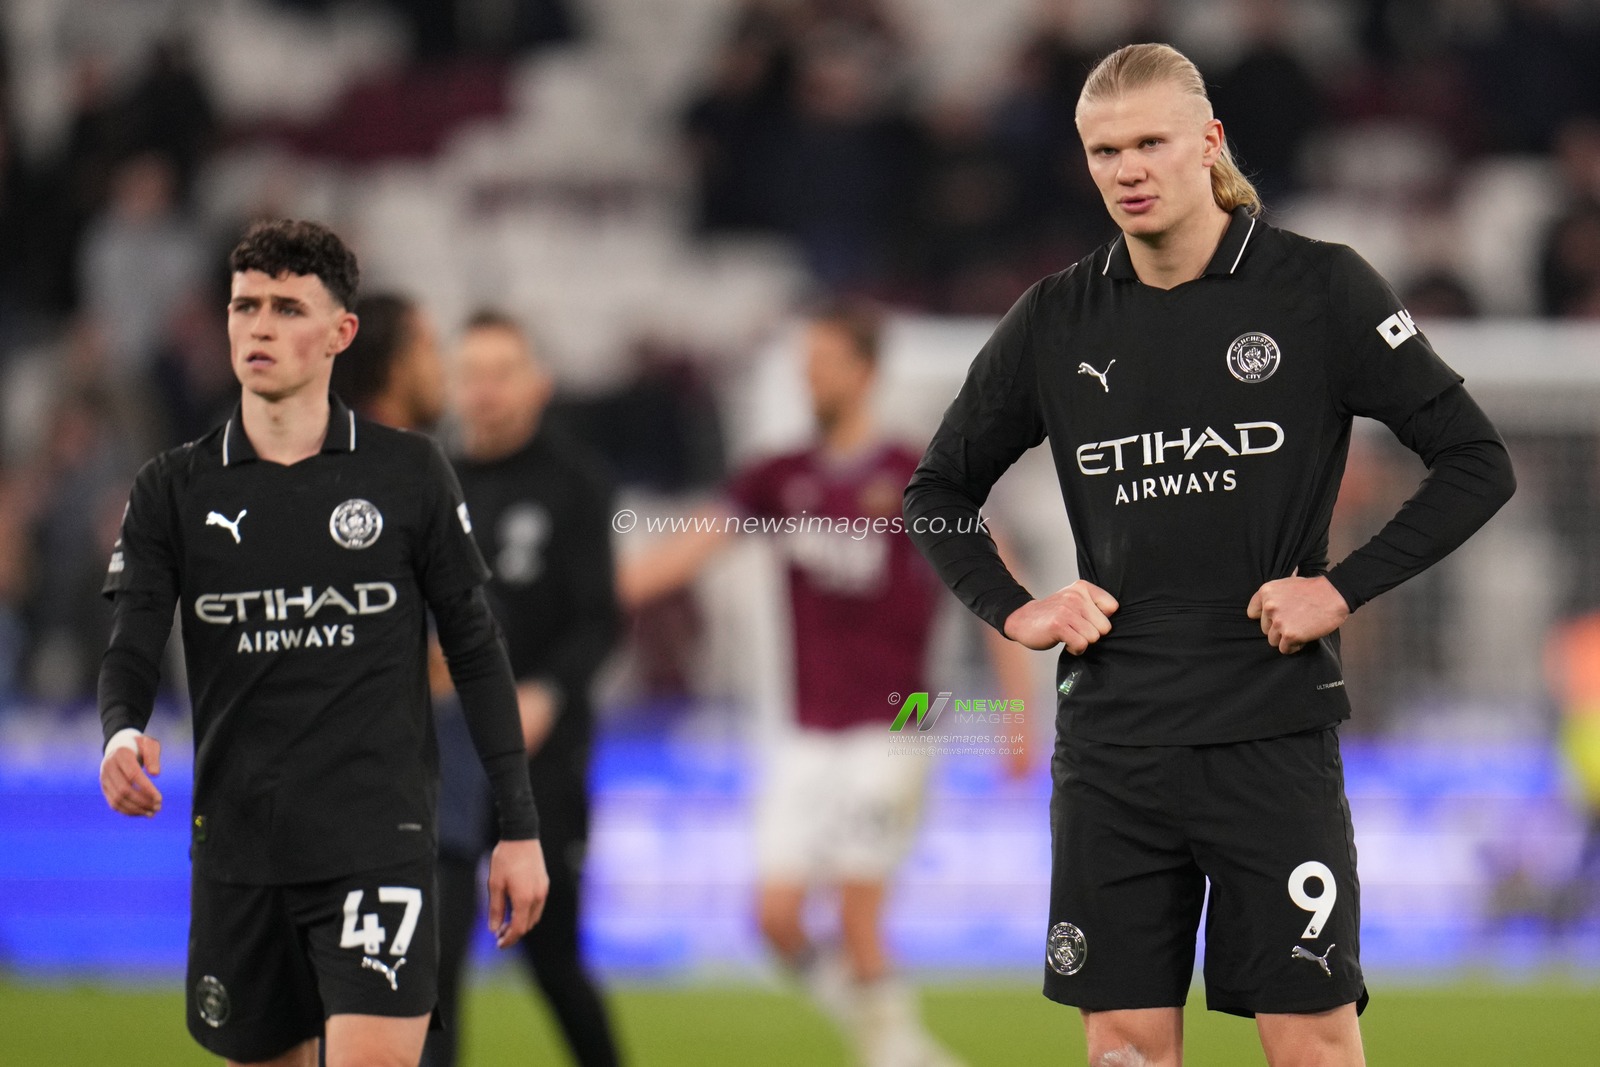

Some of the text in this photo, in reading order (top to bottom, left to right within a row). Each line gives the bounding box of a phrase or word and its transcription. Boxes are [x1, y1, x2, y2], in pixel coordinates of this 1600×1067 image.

[1233, 335, 1275, 352] MANCHESTER
[1076, 421, 1285, 476] ETIHAD
[1115, 469, 1237, 506] AIRWAYS
[194, 581, 398, 625] ETIHAD
[237, 624, 356, 654] AIRWAYS
[340, 886, 423, 956] 47
[1288, 861, 1337, 939] 9
